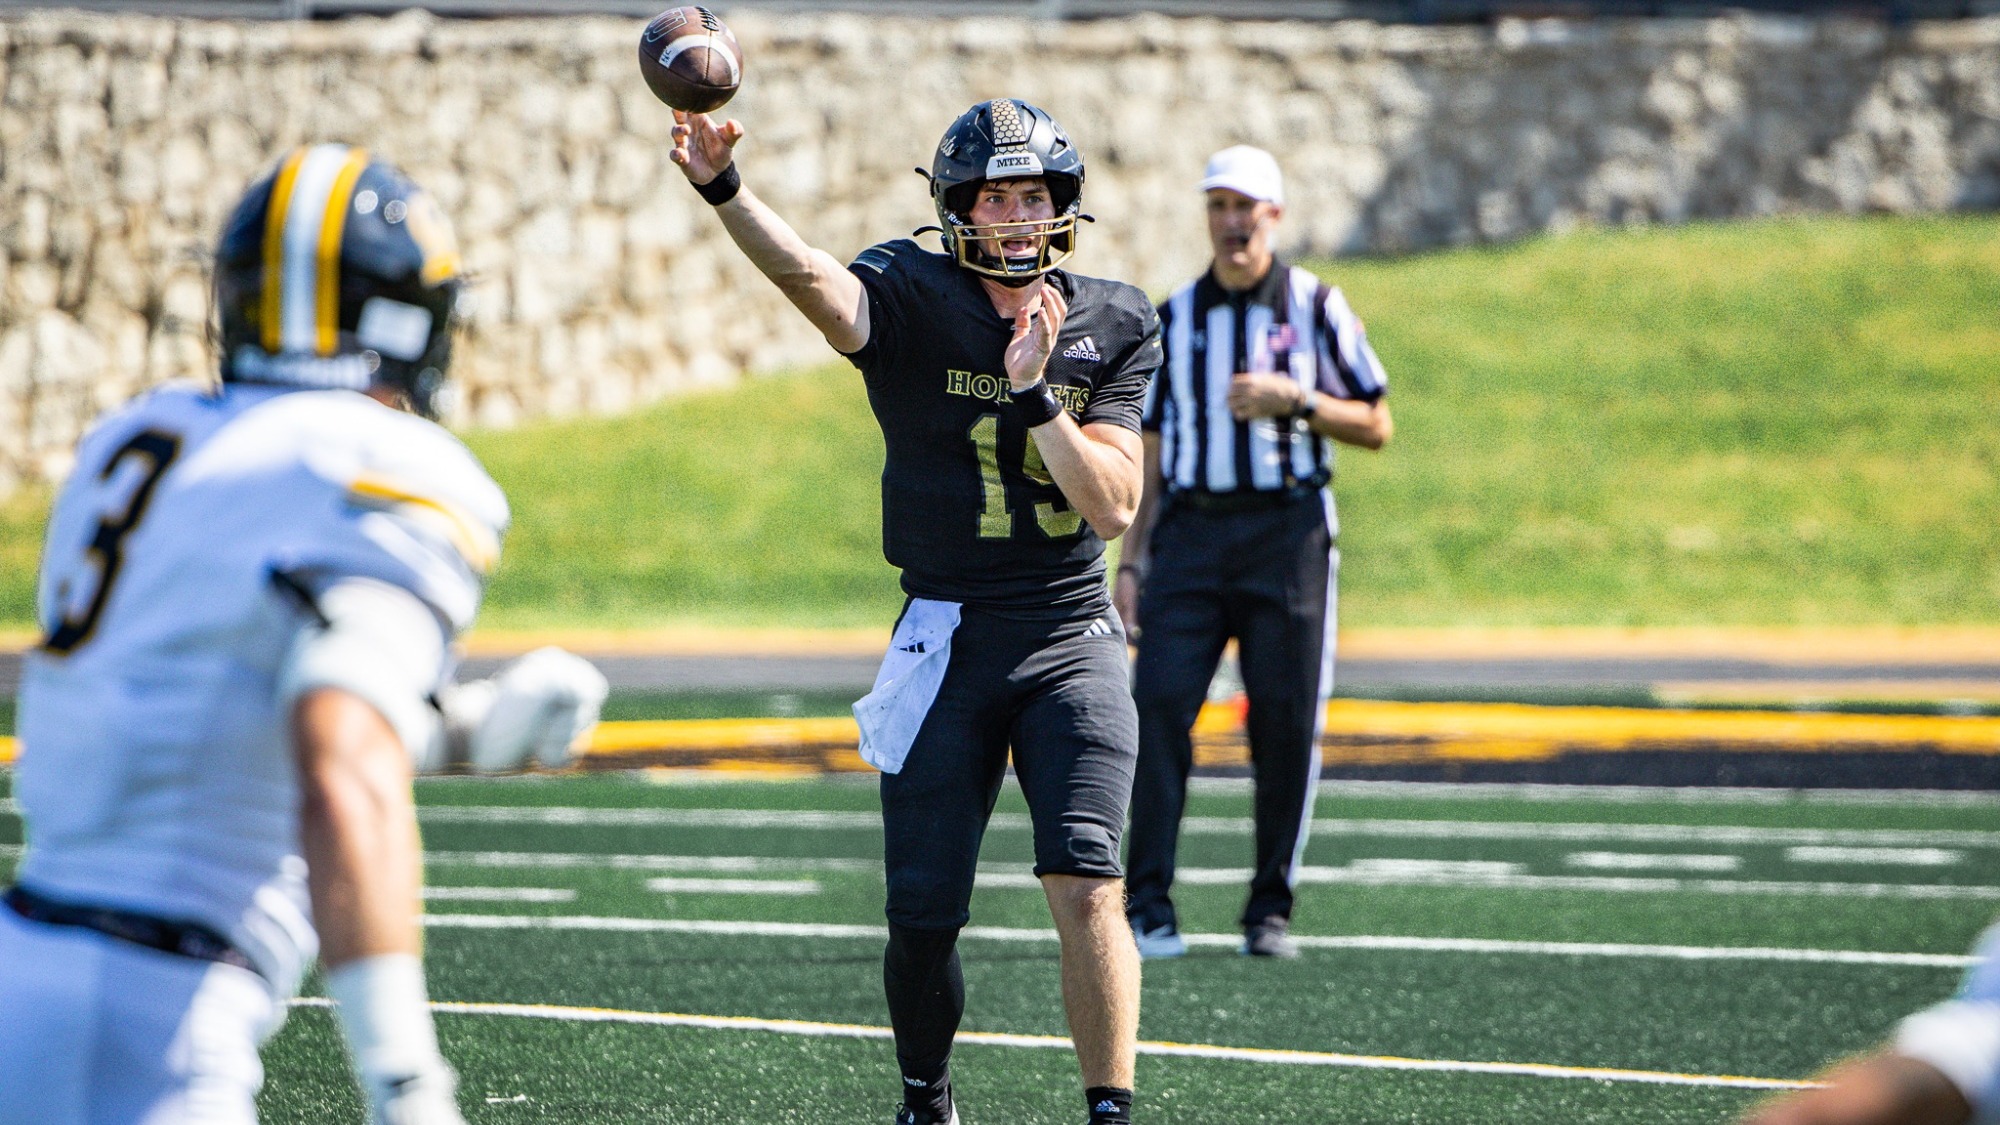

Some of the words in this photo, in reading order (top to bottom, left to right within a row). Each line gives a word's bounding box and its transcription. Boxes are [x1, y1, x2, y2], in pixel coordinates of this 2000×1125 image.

[996, 156, 1031, 168] MTXE
[1063, 348, 1101, 362] adidas
[946, 369, 1090, 412] HORETS
[967, 412, 1087, 540] 15
[39, 428, 184, 655] 3
